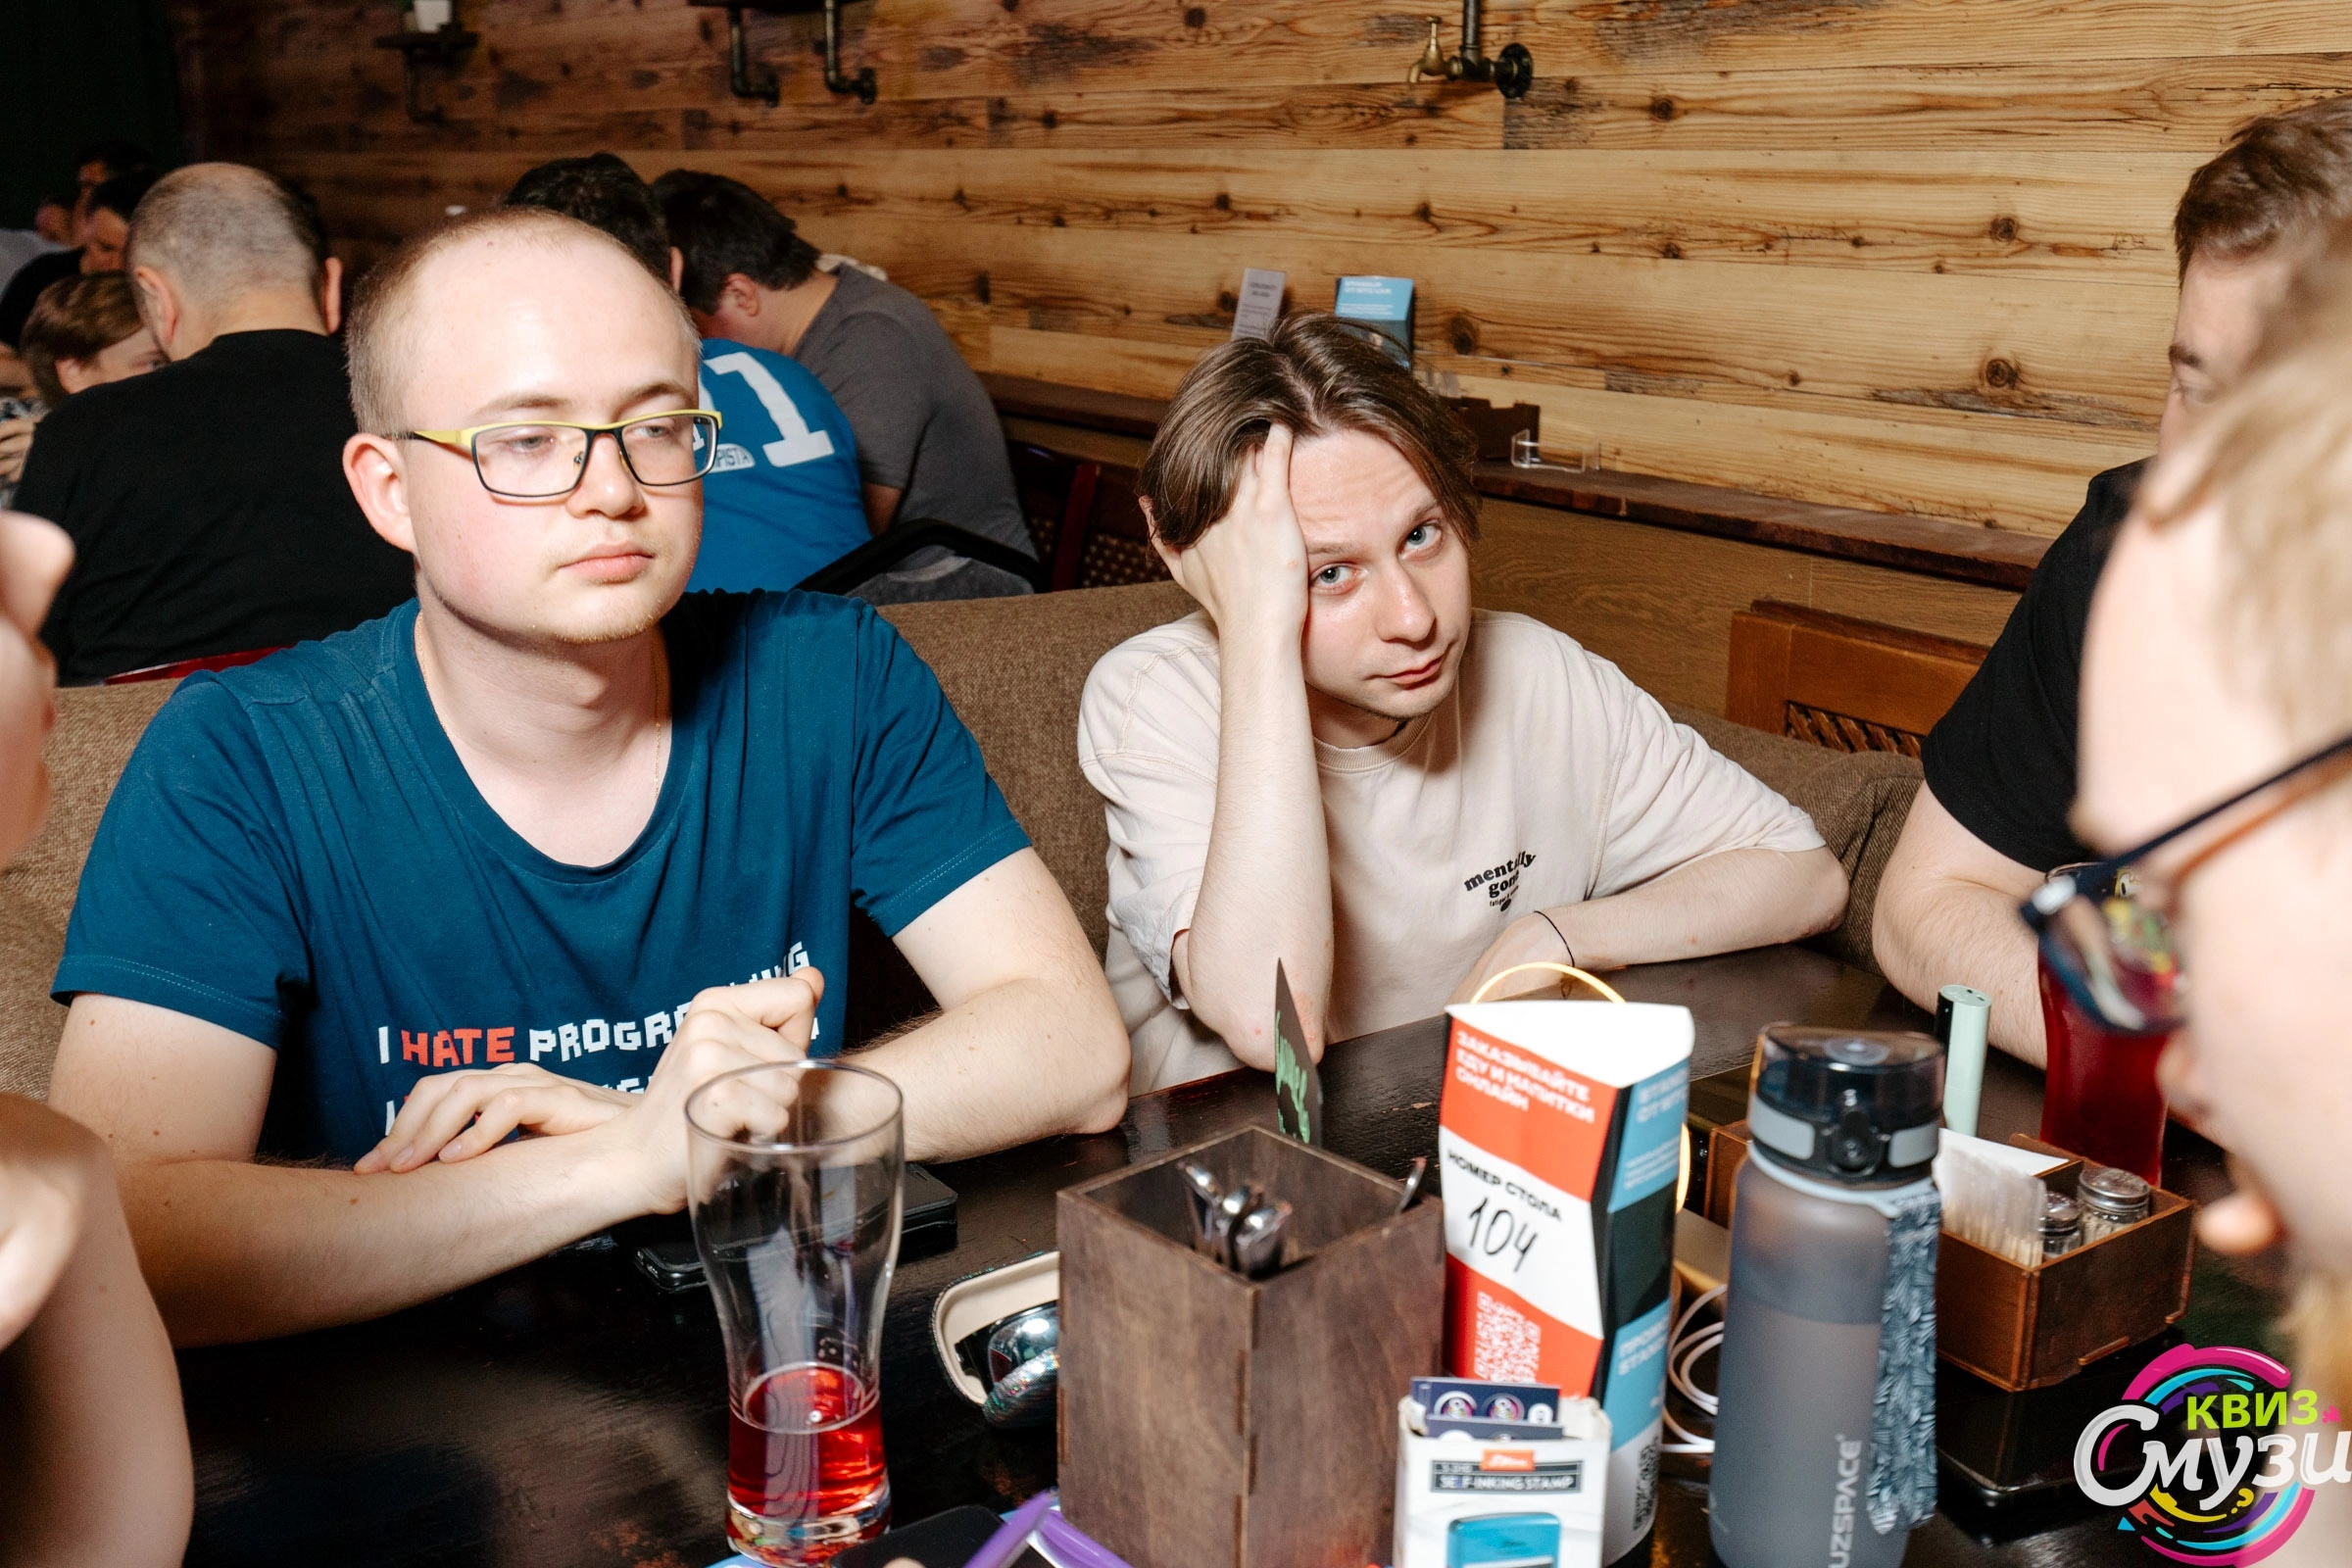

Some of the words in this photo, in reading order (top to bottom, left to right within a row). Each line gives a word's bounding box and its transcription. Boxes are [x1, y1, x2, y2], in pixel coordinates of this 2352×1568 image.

[714, 447, 751, 468] PISTA
[378, 1026, 390, 1064] I
[401, 1026, 514, 1067] HATE
[529, 941, 809, 1061] PROGRG
[1455, 1065, 1529, 1111] ОНЛАЙН
[1456, 1031, 1591, 1102] ЗАКАЗЫВАЙТЕ
[1506, 1070, 1595, 1124] НАПИТКИ
[1447, 1150, 1501, 1186] НОМЕР
[1505, 1181, 1562, 1223] СТОЛА
[1469, 1197, 1538, 1273] 104
[1524, 1474, 1576, 1491] STAMP
[1827, 1440, 1862, 1568] UZSPACE
